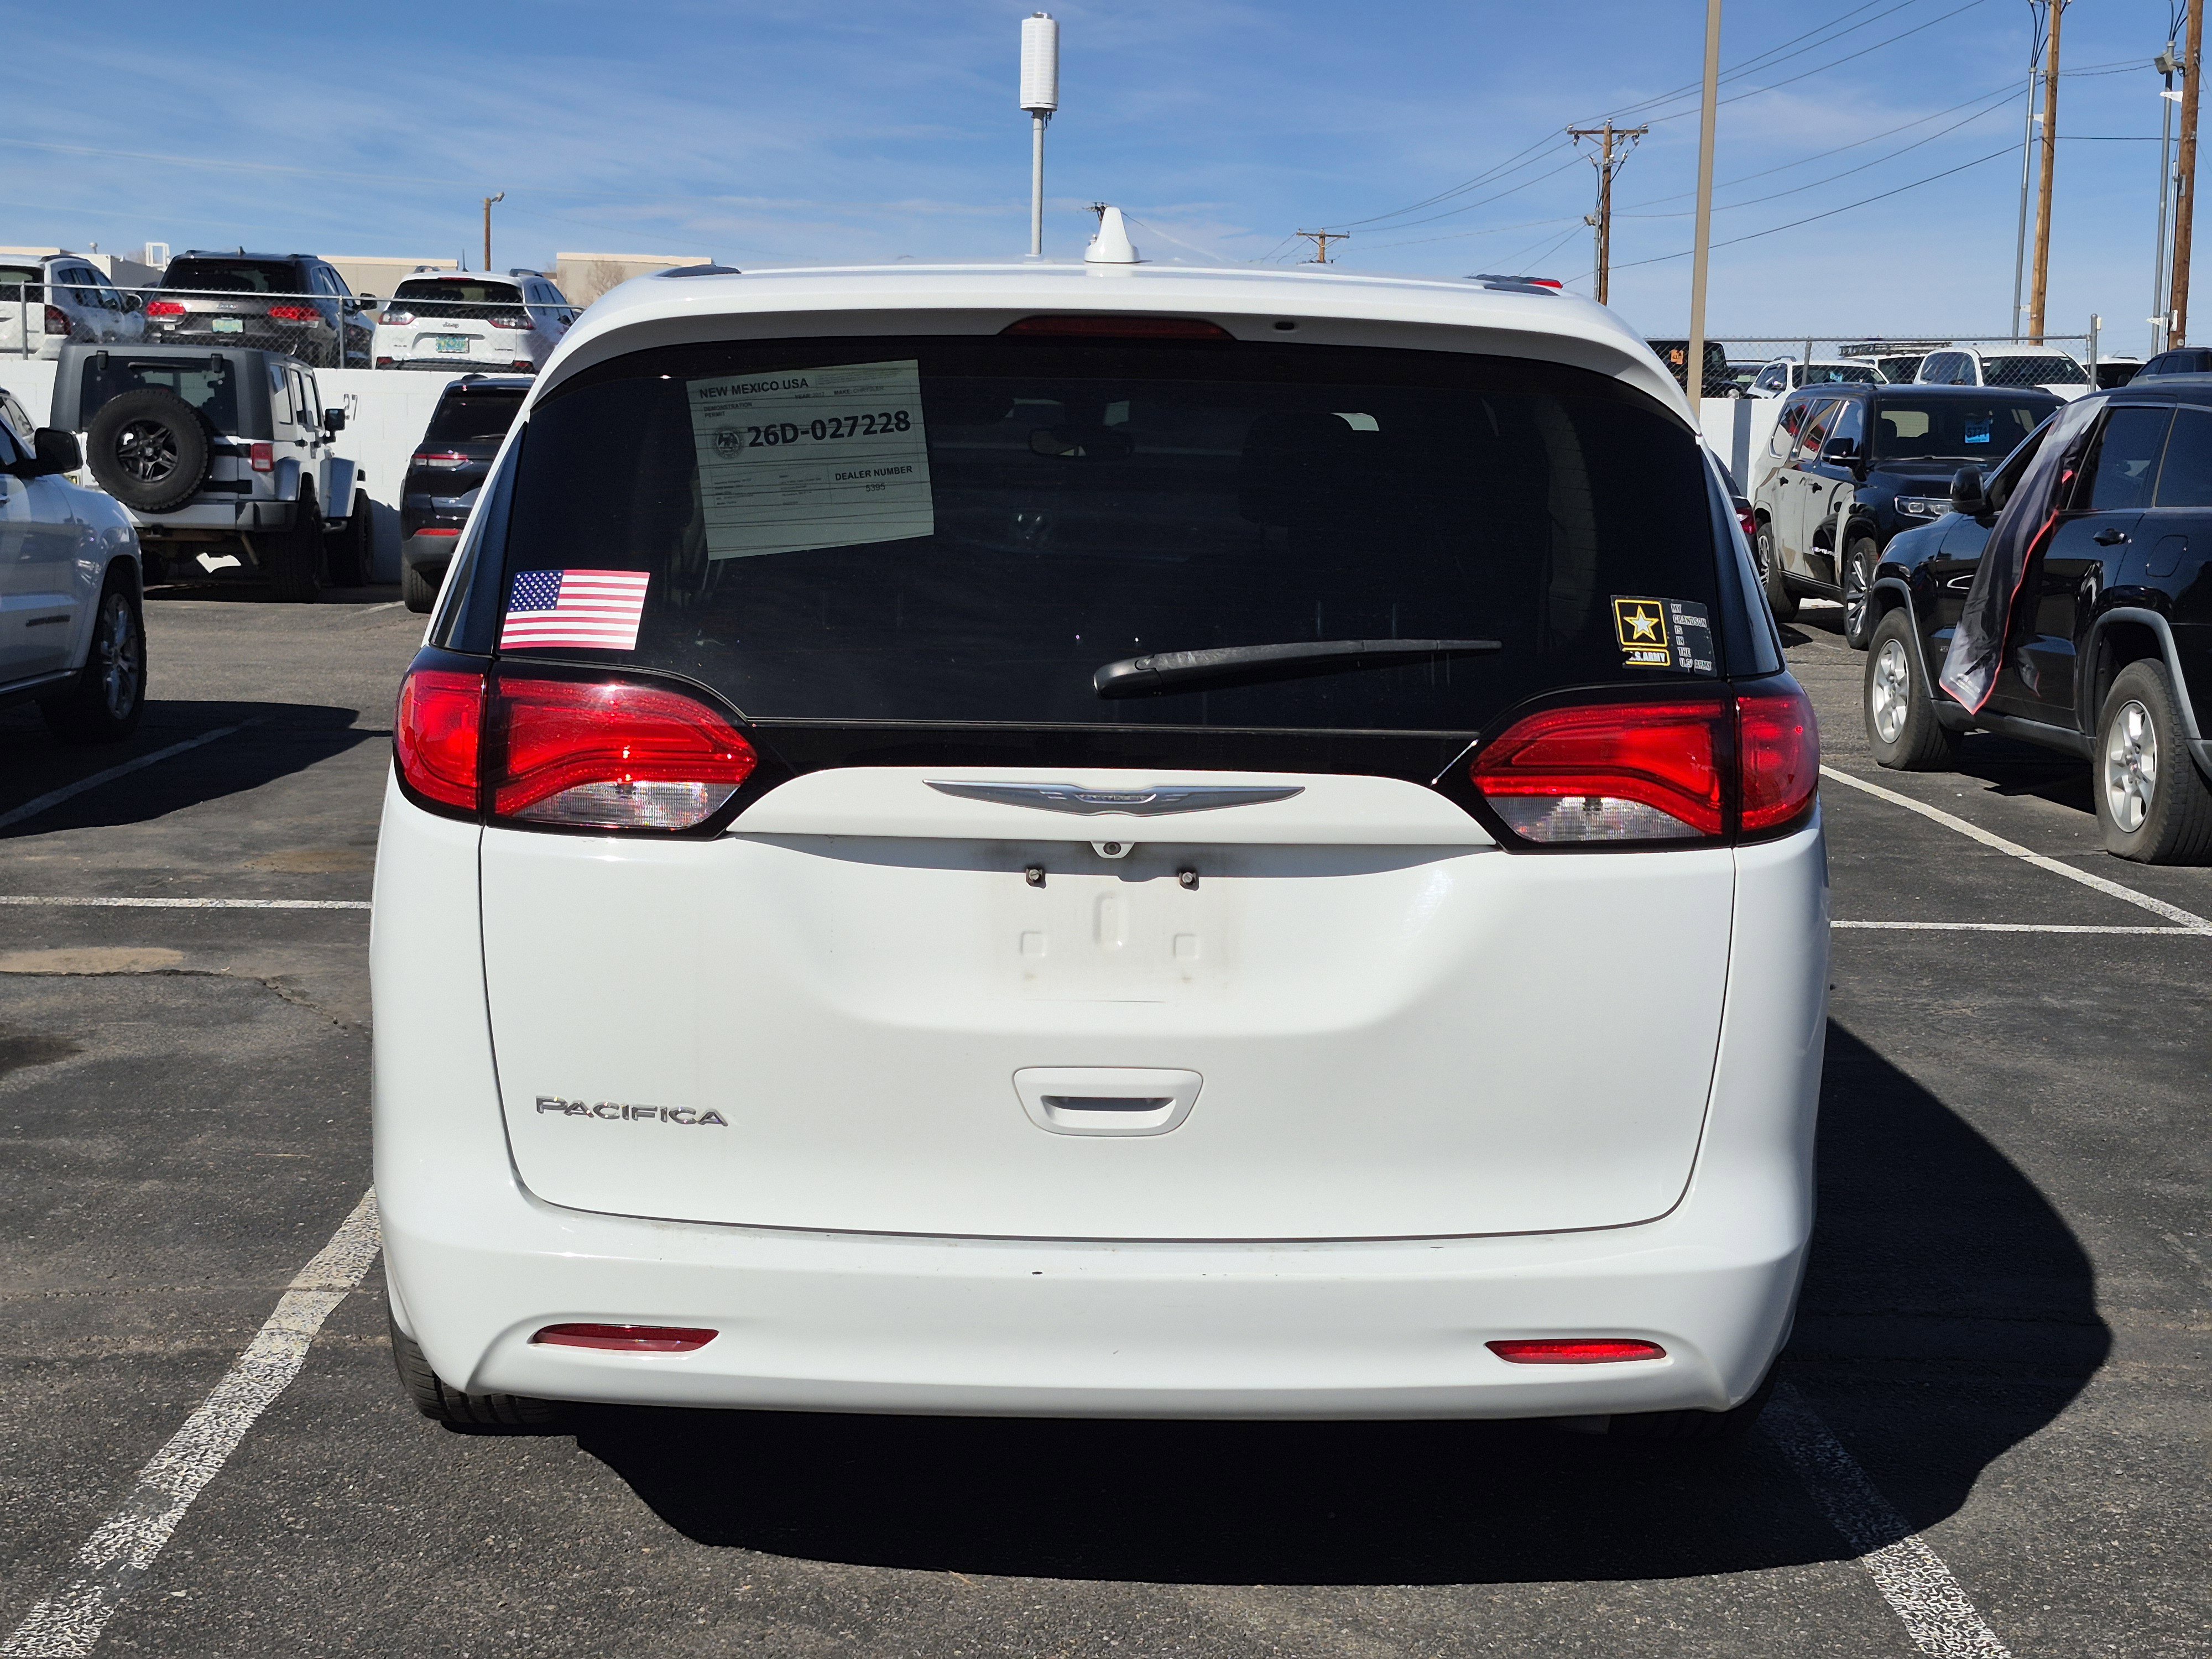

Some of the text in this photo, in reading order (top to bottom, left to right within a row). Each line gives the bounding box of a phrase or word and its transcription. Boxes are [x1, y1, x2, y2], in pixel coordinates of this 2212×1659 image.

[700, 378, 809, 399] NEW MEXICO USA
[703, 401, 753, 411] DEMONSTRATION
[747, 410, 911, 448] 26D-027228
[835, 466, 913, 481] DEALER NUMBER
[865, 483, 886, 492] 5395
[1671, 603, 1682, 613] MY
[1674, 625, 1683, 635] IS
[1676, 636, 1685, 646] IN
[1678, 647, 1692, 657] THE
[1694, 659, 1712, 671] ARMY
[535, 1095, 729, 1127] PACIFICA
